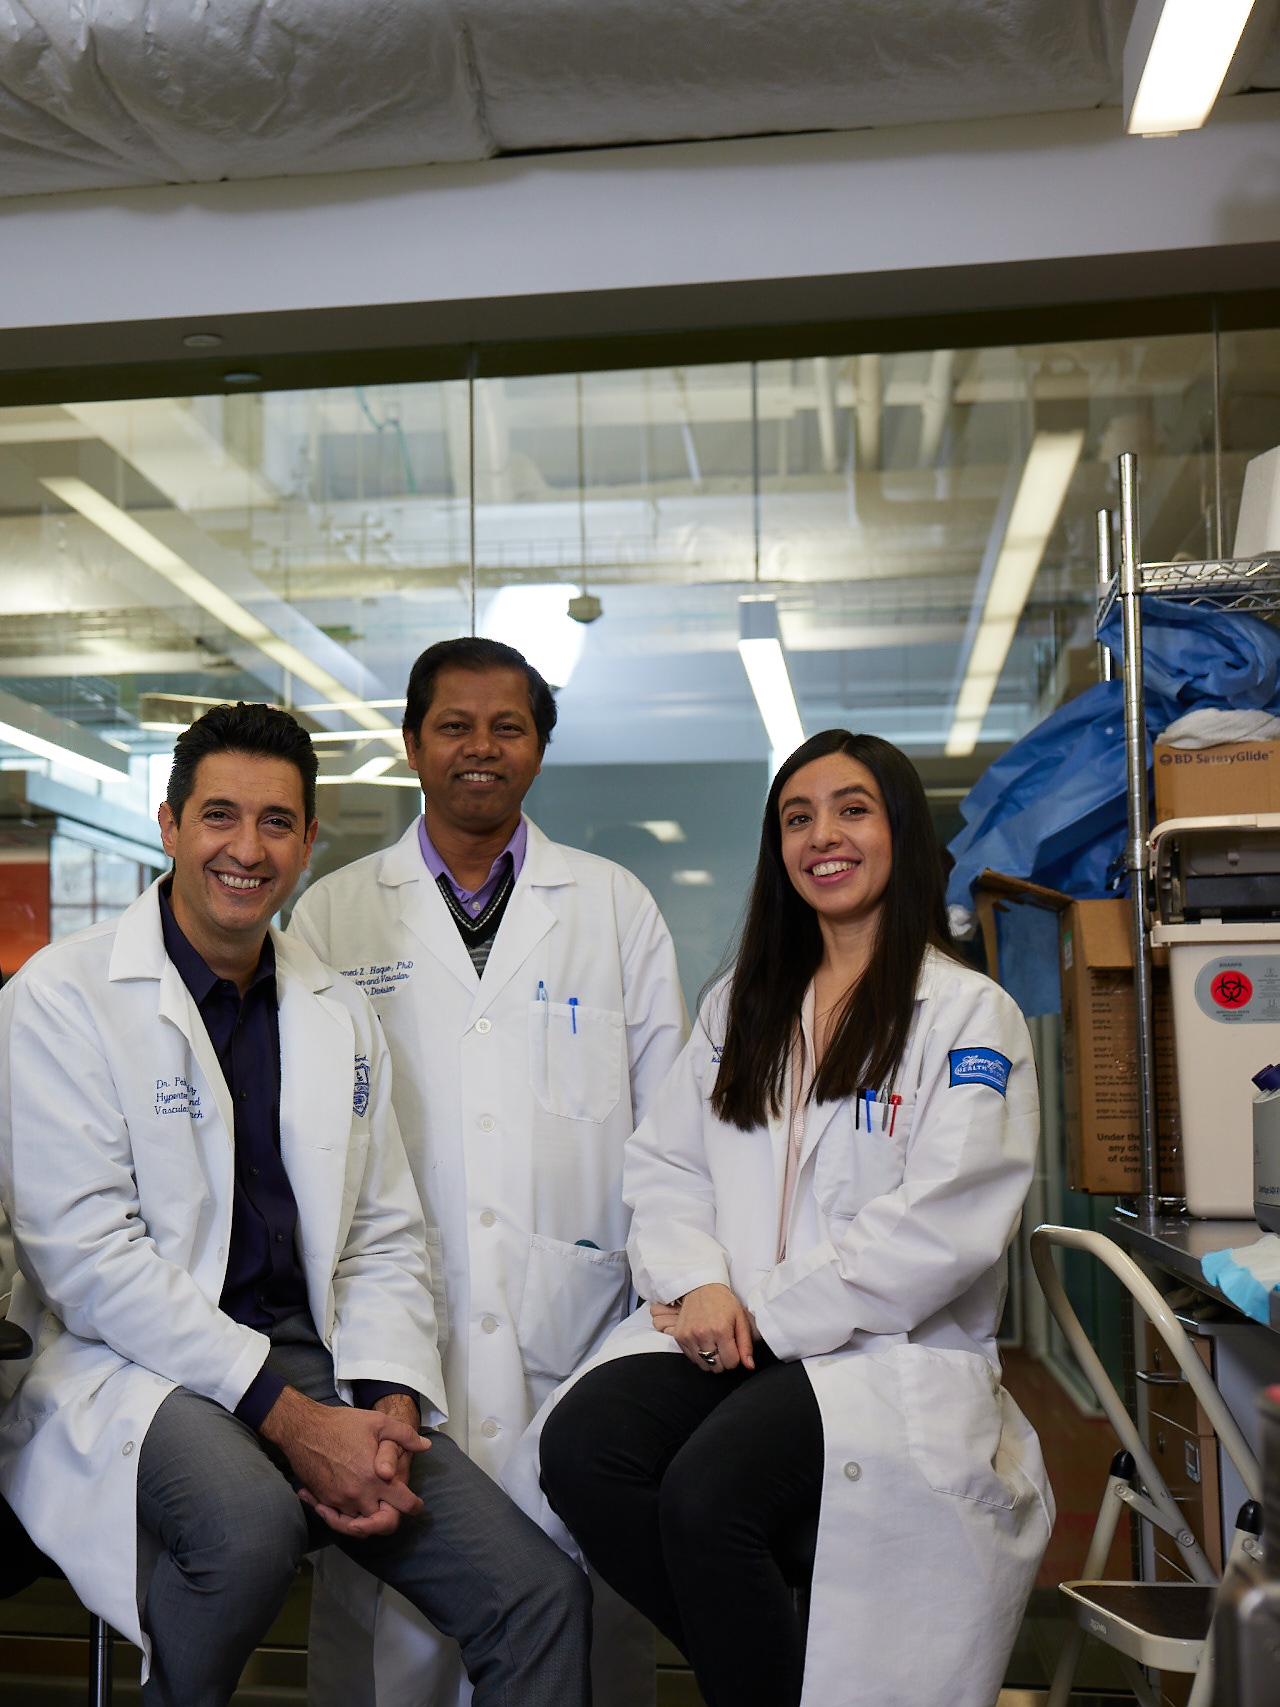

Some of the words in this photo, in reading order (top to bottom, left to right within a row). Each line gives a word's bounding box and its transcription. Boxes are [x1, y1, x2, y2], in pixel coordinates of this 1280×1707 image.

[1174, 753, 1193, 764] BD
[1097, 1133, 1124, 1142] Under
[1109, 1145, 1126, 1154] any
[1107, 1155, 1118, 1163] of
